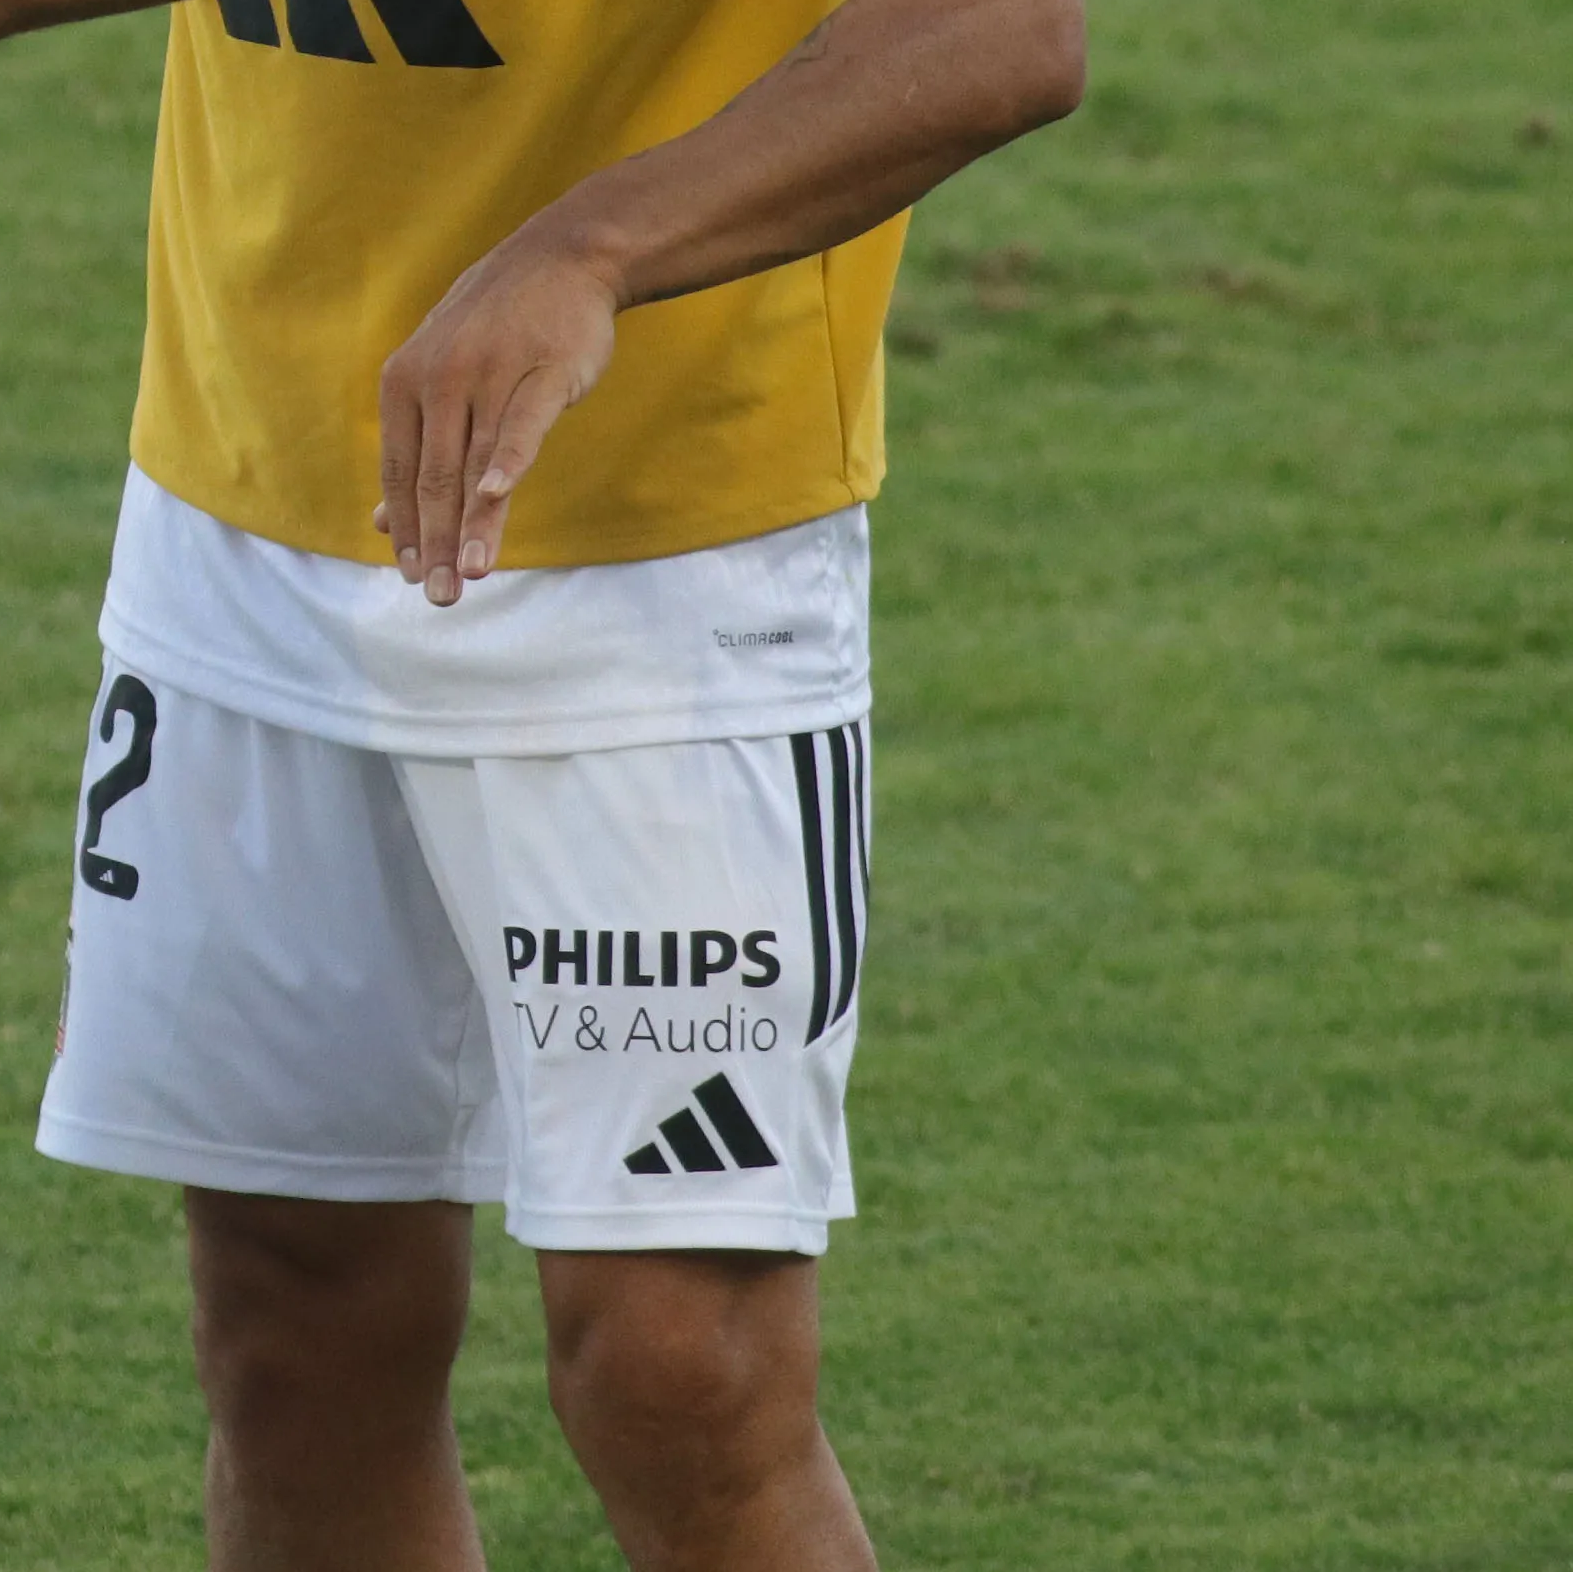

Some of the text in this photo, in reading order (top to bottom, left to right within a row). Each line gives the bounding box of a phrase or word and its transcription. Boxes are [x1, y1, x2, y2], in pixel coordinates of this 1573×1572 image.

[79, 673, 157, 901] 2
[502, 926, 781, 988] PHILIPS
[575, 1005, 607, 1052] &
[623, 1004, 778, 1053] Audio
